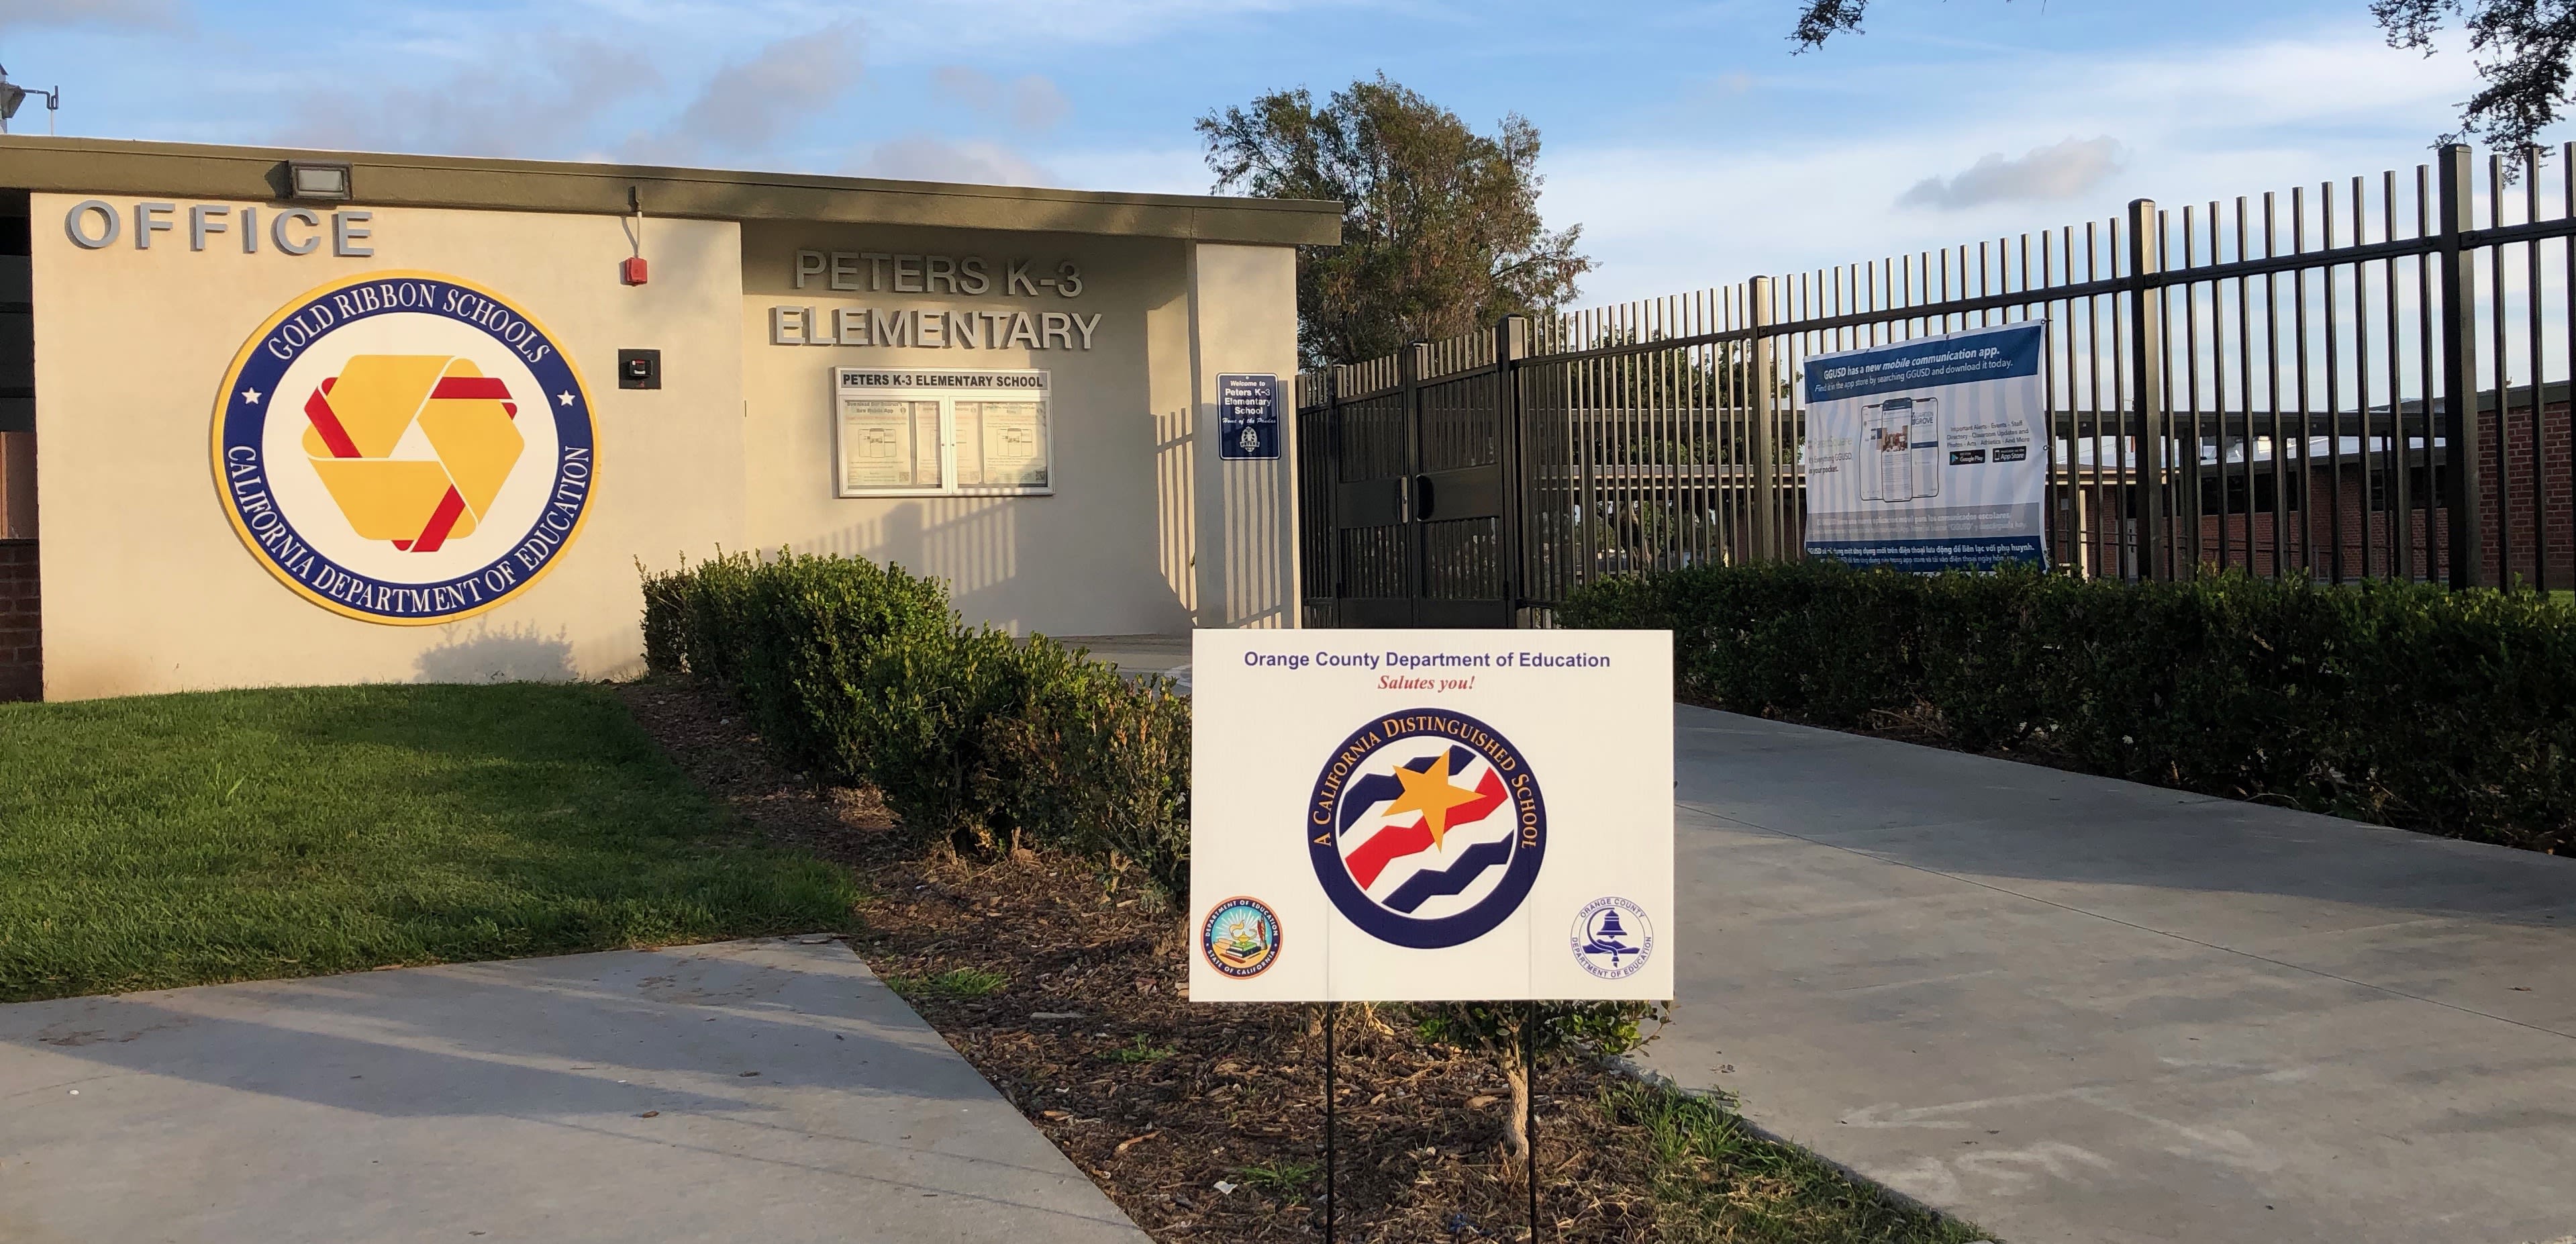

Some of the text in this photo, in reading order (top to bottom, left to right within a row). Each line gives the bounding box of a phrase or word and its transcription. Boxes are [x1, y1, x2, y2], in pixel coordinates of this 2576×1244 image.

[68, 199, 375, 256] OFFICE
[795, 250, 1083, 297] PETERS K-3
[268, 282, 551, 363] GOLD RIBBON SCHOOLS
[775, 305, 1102, 349] ELEMENTARY
[1814, 384, 1826, 393] Find
[1836, 381, 1844, 390] the
[1844, 381, 1854, 390] app
[1855, 378, 1869, 387] store
[1869, 375, 1877, 386] by
[1877, 371, 1905, 384] searching
[1905, 368, 1930, 379] GGUSD
[1932, 366, 1944, 376] and
[1945, 361, 1981, 374] download
[1982, 361, 1987, 369] it
[1988, 358, 2014, 369] today.
[1824, 367, 1846, 380] GGUSD
[1847, 365, 1859, 376] has
[1865, 364, 1881, 373] new
[1882, 358, 1910, 371] mobile
[1912, 348, 1977, 366] communication
[1979, 346, 2000, 359] app.
[843, 373, 1044, 387] PETERS K-3 ELEMENTARY SCHOOL
[1225, 388, 1271, 396] Peters K-3
[1224, 397, 1271, 407] Elementary
[1997, 429, 2018, 437] Updates
[1834, 452, 1852, 461] GGUSD
[1812, 468, 1822, 476] your
[1822, 465, 1839, 475] pocket.
[228, 445, 590, 613] CALIFORNIA DEPARTMENT OF EDUCATION
[1962, 544, 1975, 553] liên
[1975, 544, 1985, 554] lạc
[1997, 543, 2010, 554] phụ
[2011, 542, 2035, 553] huynh.
[1244, 651, 1611, 670] Orange County Department of Education
[1378, 675, 1475, 693] Salutes you!
[1314, 716, 1538, 849] A CALIFORNIA DISTINGUISHED SCHOOL
[1205, 900, 1236, 937] DEPARTMENT
[1252, 902, 1278, 936] EDUCATION
[1580, 898, 1645, 918] ORANGE COUNTY
[1208, 949, 1222, 967] STATE
[1236, 951, 1275, 975] CALIFORNIA
[1572, 937, 1608, 977] DEPARTMENT
[1624, 936, 1651, 975] EDUCATION
